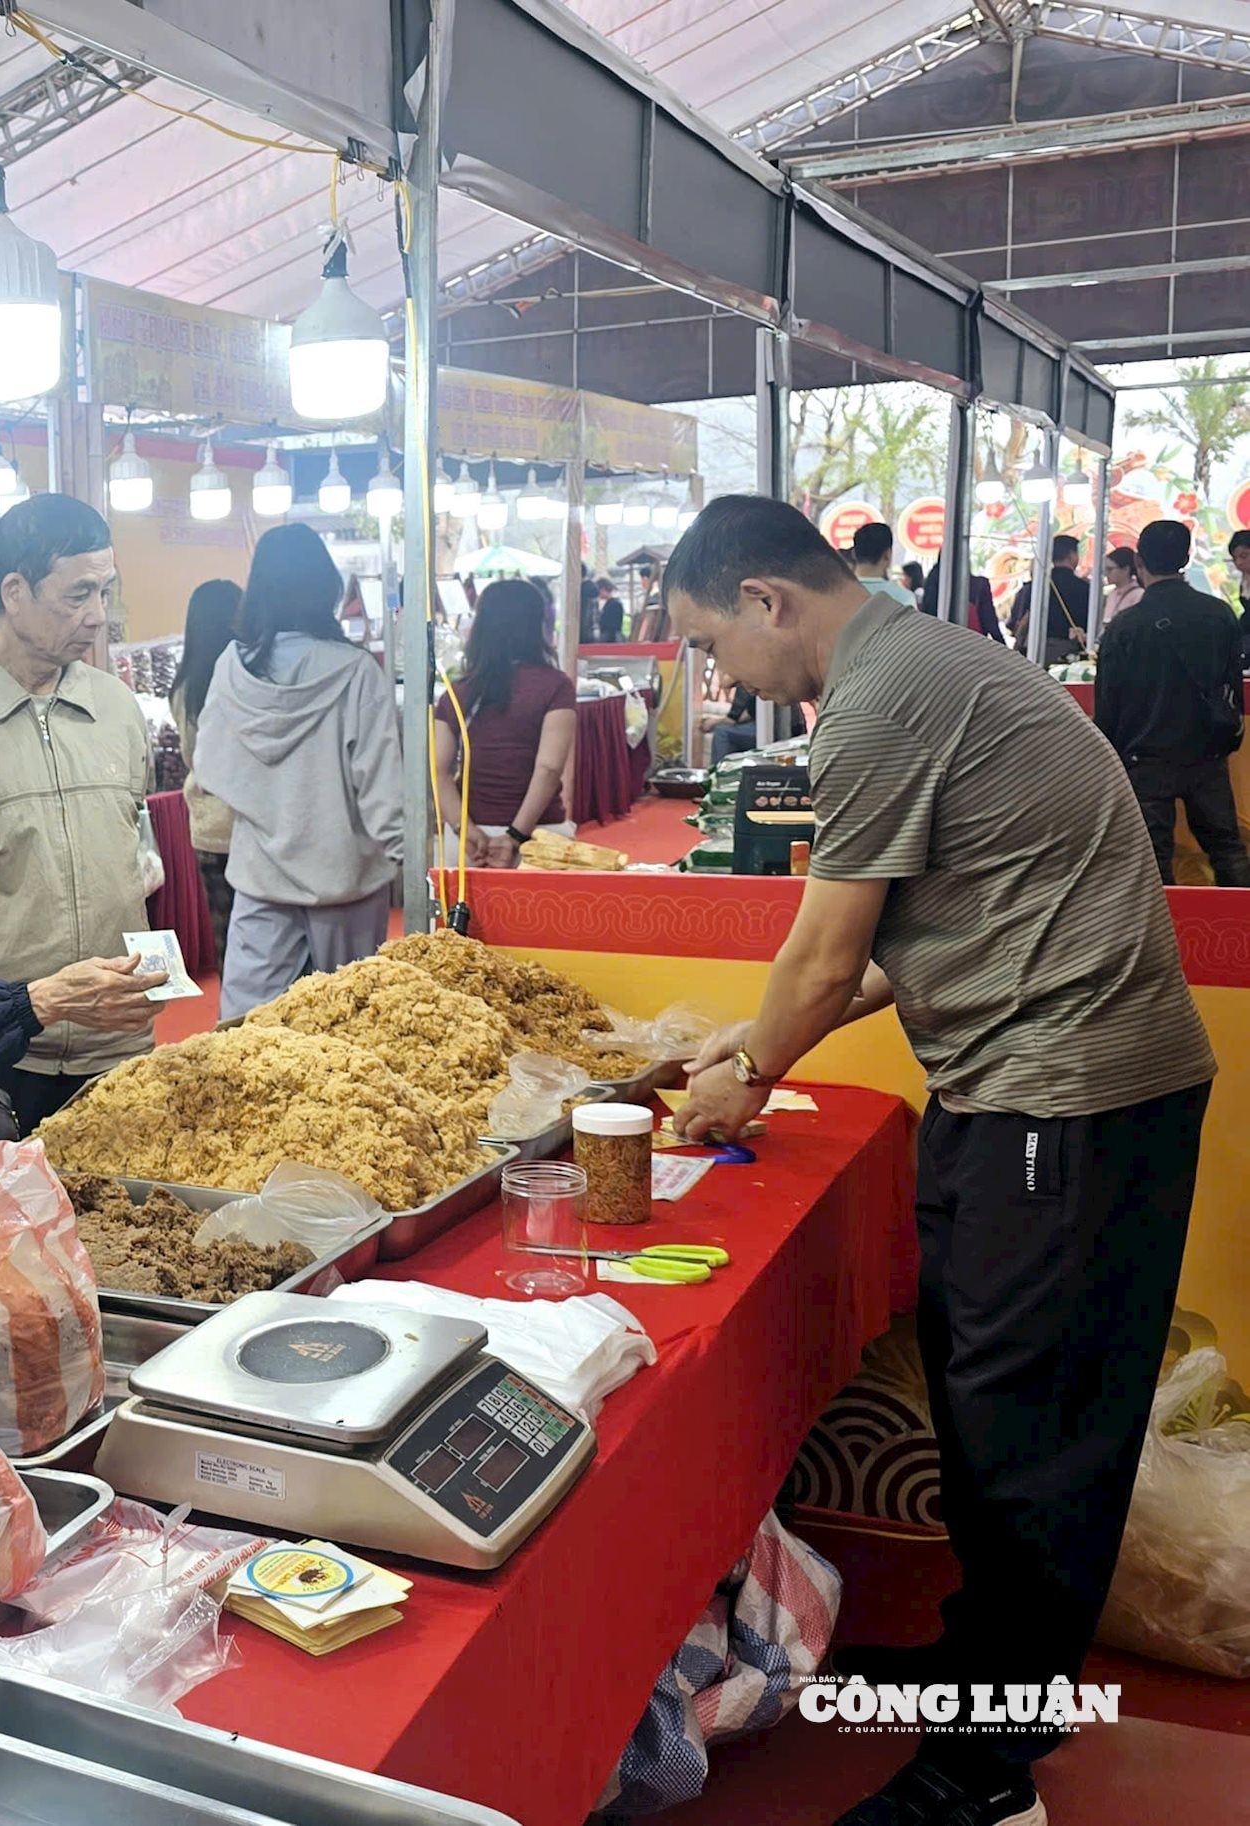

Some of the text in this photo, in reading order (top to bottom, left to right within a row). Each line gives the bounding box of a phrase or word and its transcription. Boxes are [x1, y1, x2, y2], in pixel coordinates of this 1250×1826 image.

[1025, 1132, 1038, 1192] MAXTINO
[481, 1389, 508, 1413] 7 8 9
[497, 1415, 511, 1426] 4
[505, 1408, 518, 1419] 5
[512, 1401, 525, 1412] 6
[516, 1428, 529, 1439] 1
[523, 1421, 536, 1432] 2
[530, 1414, 542, 1425] 3
[533, 1442, 545, 1453] 0
